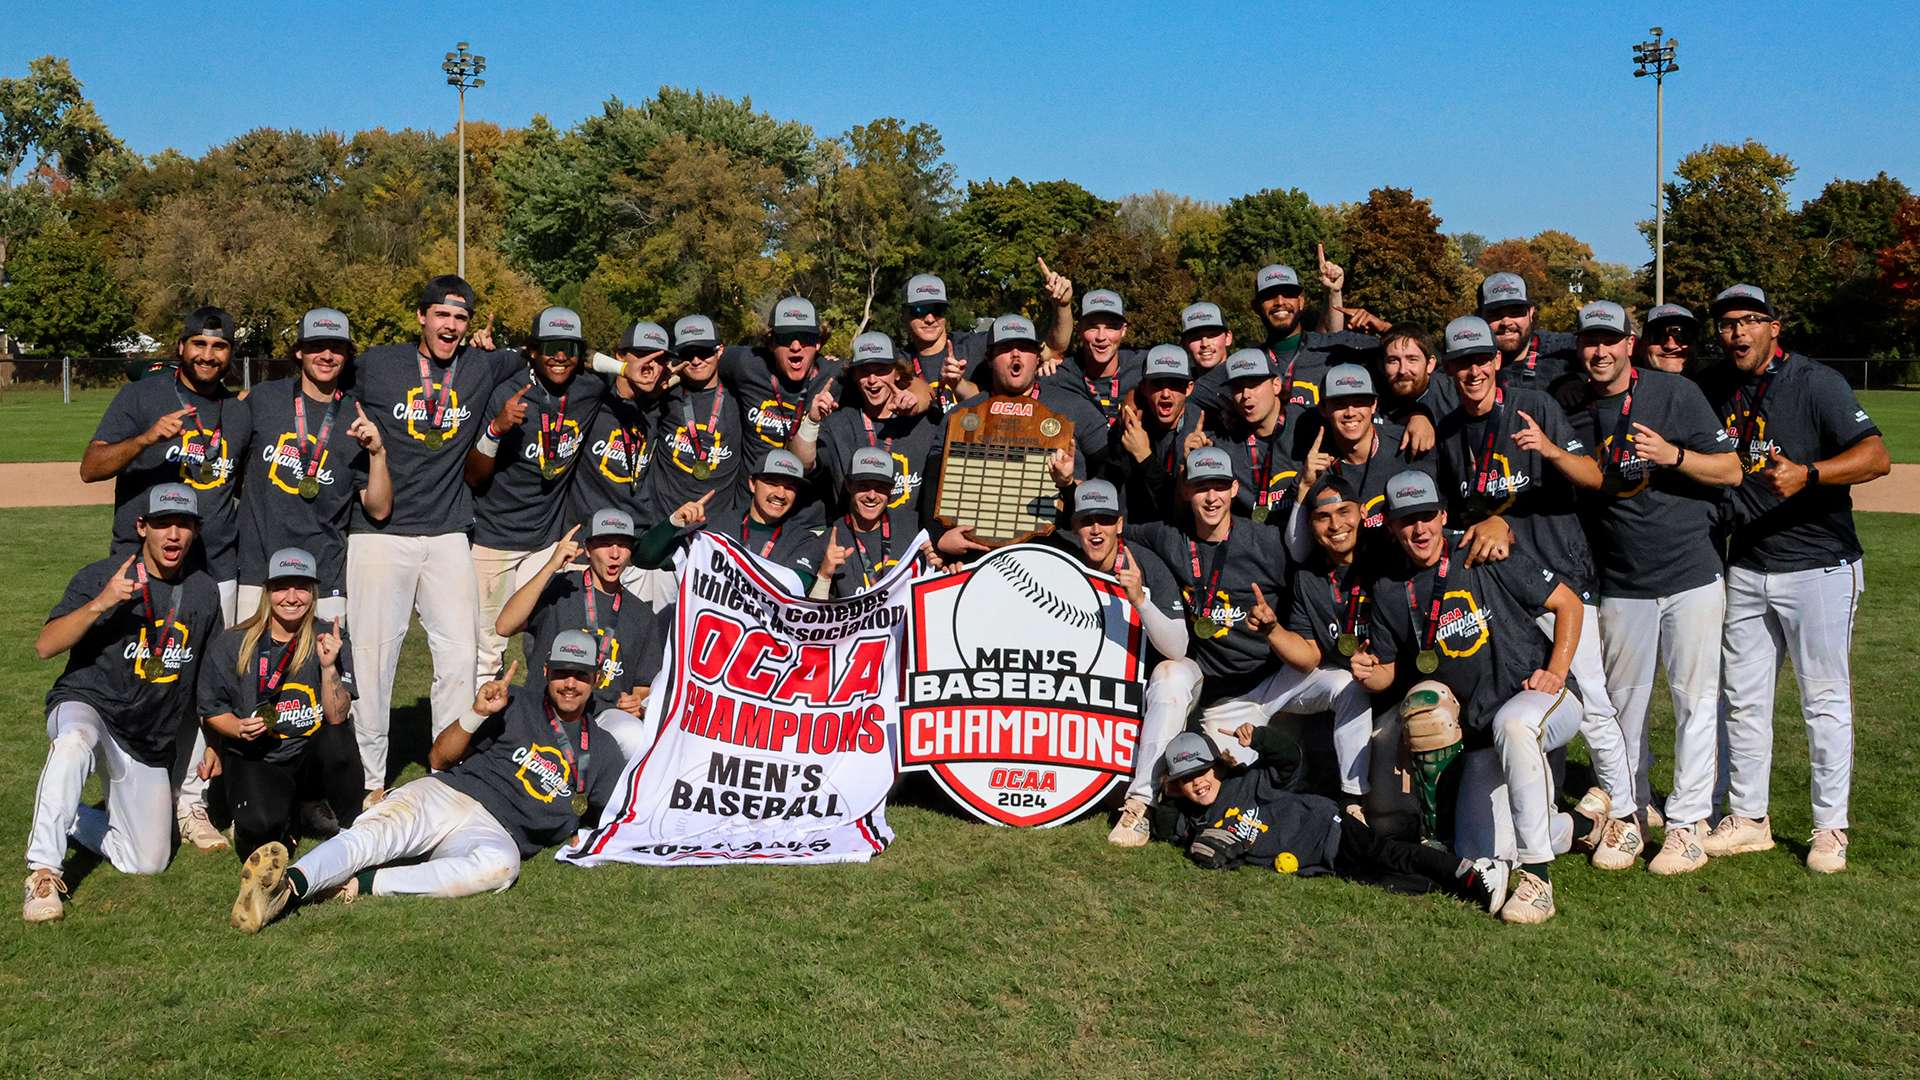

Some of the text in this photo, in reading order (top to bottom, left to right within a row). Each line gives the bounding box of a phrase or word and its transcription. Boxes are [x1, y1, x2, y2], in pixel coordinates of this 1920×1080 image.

[990, 401, 1033, 416] OCAA
[688, 609, 890, 707] OCAA
[976, 647, 1077, 673] MEN'S
[914, 671, 1138, 713] BASEBALL
[680, 681, 885, 754] CHAMPIONS
[910, 709, 1138, 768] CHAMPIONS
[707, 752, 823, 793] MEN'S
[989, 768, 1057, 792] OCAA
[669, 779, 843, 820] BASEBALL
[998, 793, 1047, 808] 2024
